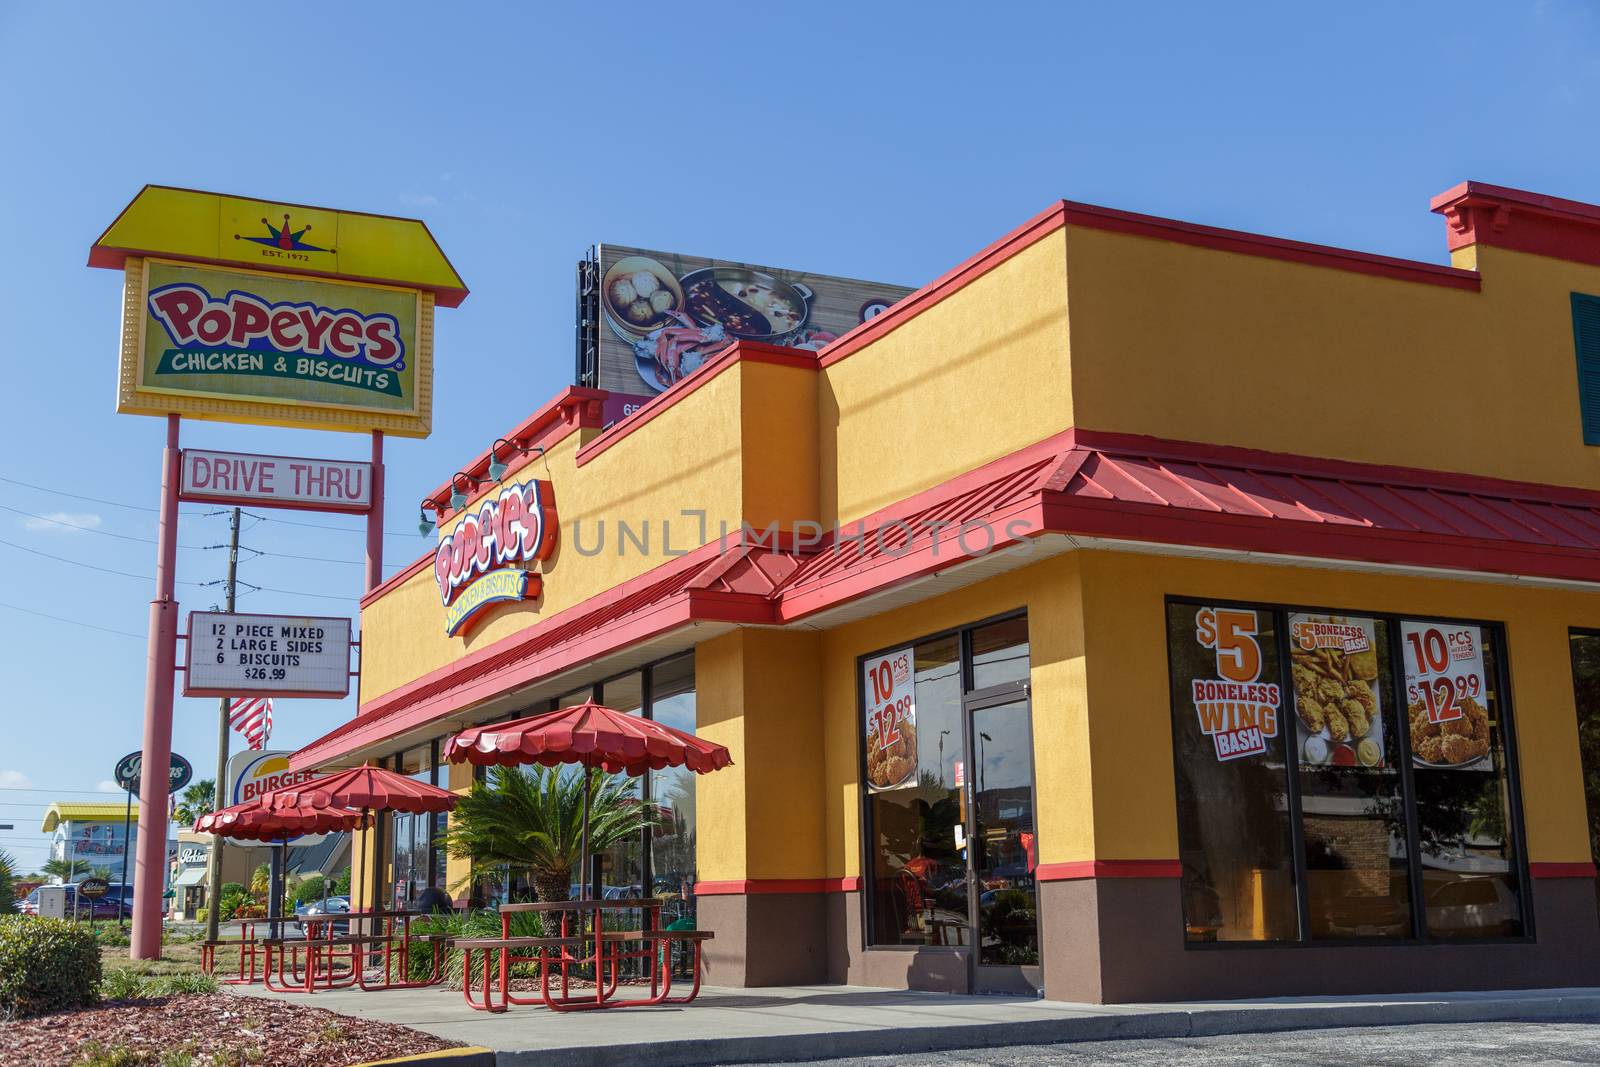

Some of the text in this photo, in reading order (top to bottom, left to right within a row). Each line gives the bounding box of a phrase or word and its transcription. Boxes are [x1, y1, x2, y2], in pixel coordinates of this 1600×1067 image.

[262, 249, 309, 262] EST. 1972
[171, 353, 389, 389] CHICKEN & BISCUITS
[191, 457, 363, 500] DRIVE THRU
[451, 587, 480, 624] CHICKEN
[485, 573, 516, 597] BISCUITS
[212, 624, 324, 640] 12 PIECE MIXED
[1293, 622, 1316, 650] $5
[1314, 624, 1364, 639] BONELESS
[1316, 636, 1344, 648] WING
[1448, 631, 1473, 646] PCS
[216, 638, 323, 654] 2 LARGE SIDES
[1197, 610, 1260, 683] $5
[1344, 638, 1367, 651] BASH
[1406, 627, 1449, 675] 10
[216, 652, 300, 667] 6 BISCUITS
[893, 654, 908, 673] PCS
[245, 668, 286, 680] $26.99
[869, 659, 893, 706] 10
[1194, 682, 1279, 706] BONELESS
[1199, 702, 1276, 735] WING
[1216, 728, 1262, 755] BASH
